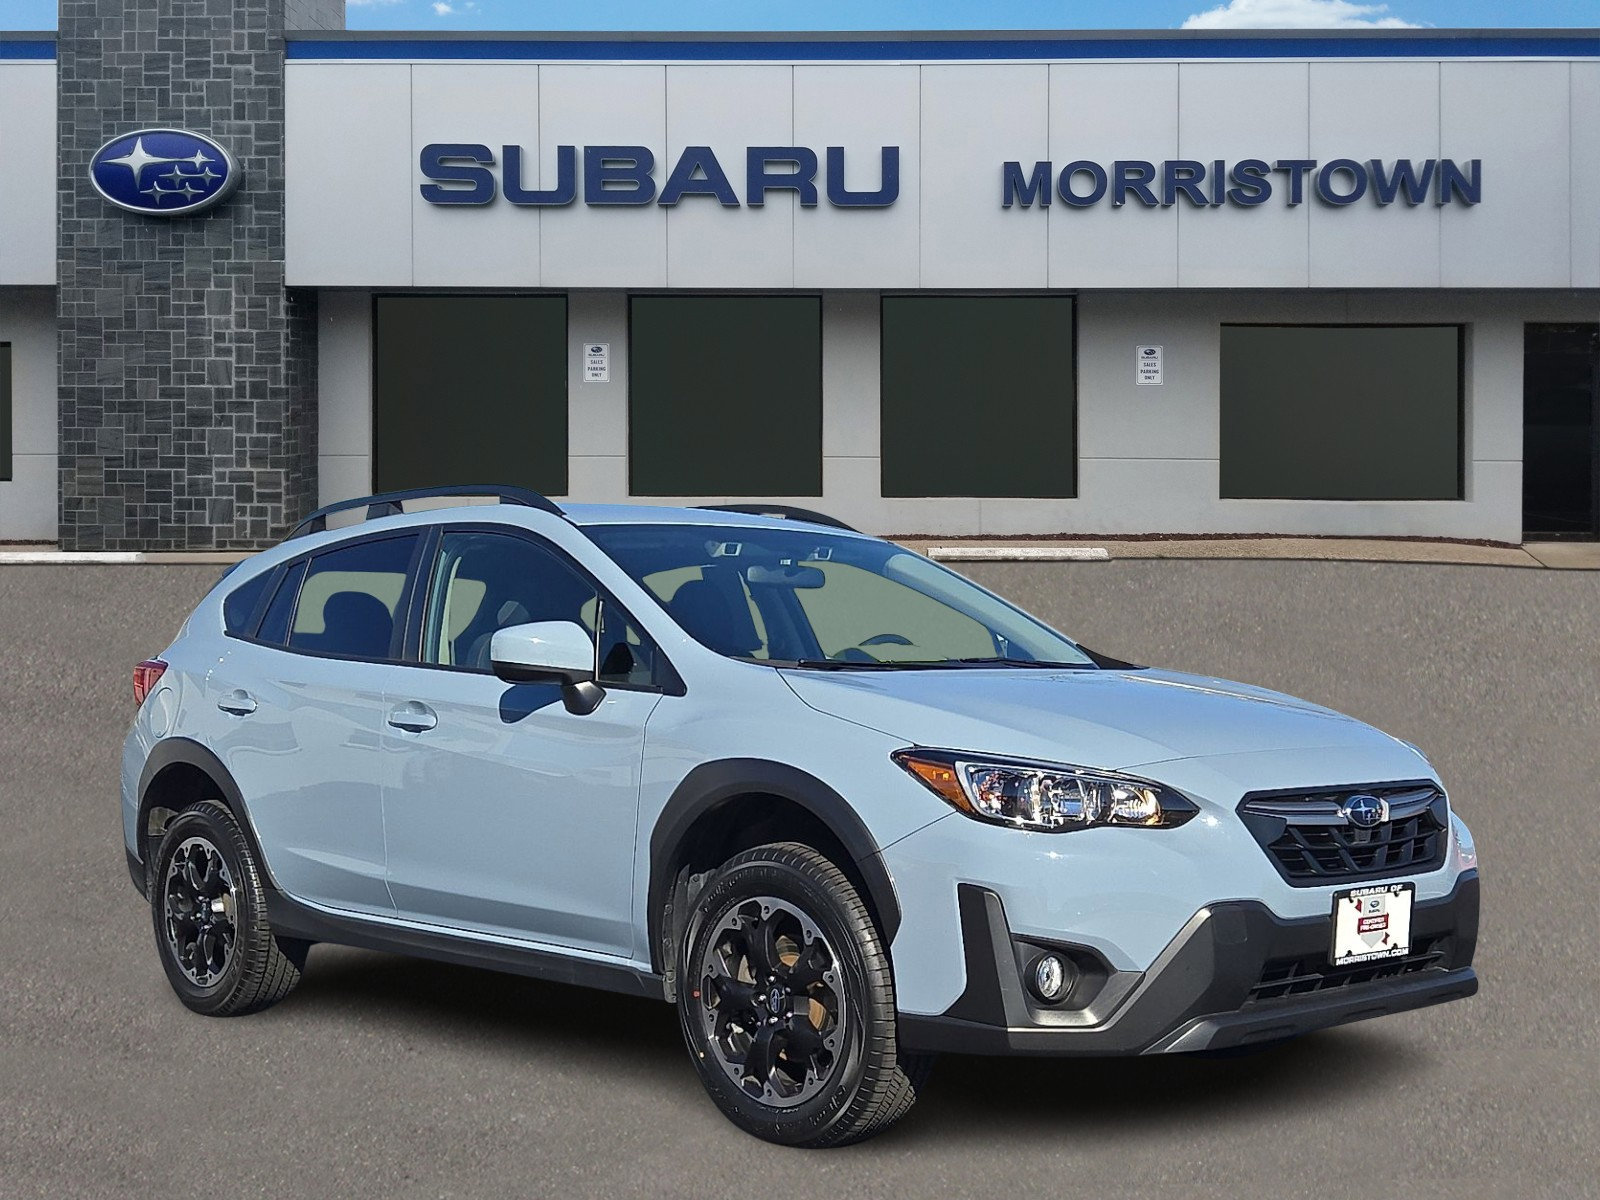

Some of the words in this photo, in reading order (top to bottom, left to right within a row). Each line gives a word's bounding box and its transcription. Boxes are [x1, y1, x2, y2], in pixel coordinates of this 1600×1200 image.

[419, 143, 900, 207] SUBARU
[1002, 158, 1483, 208] MORRISTOWN
[1350, 885, 1388, 897] SUBARU
[1390, 884, 1403, 892] OF
[1336, 948, 1409, 965] MORRISTOWN.COM
